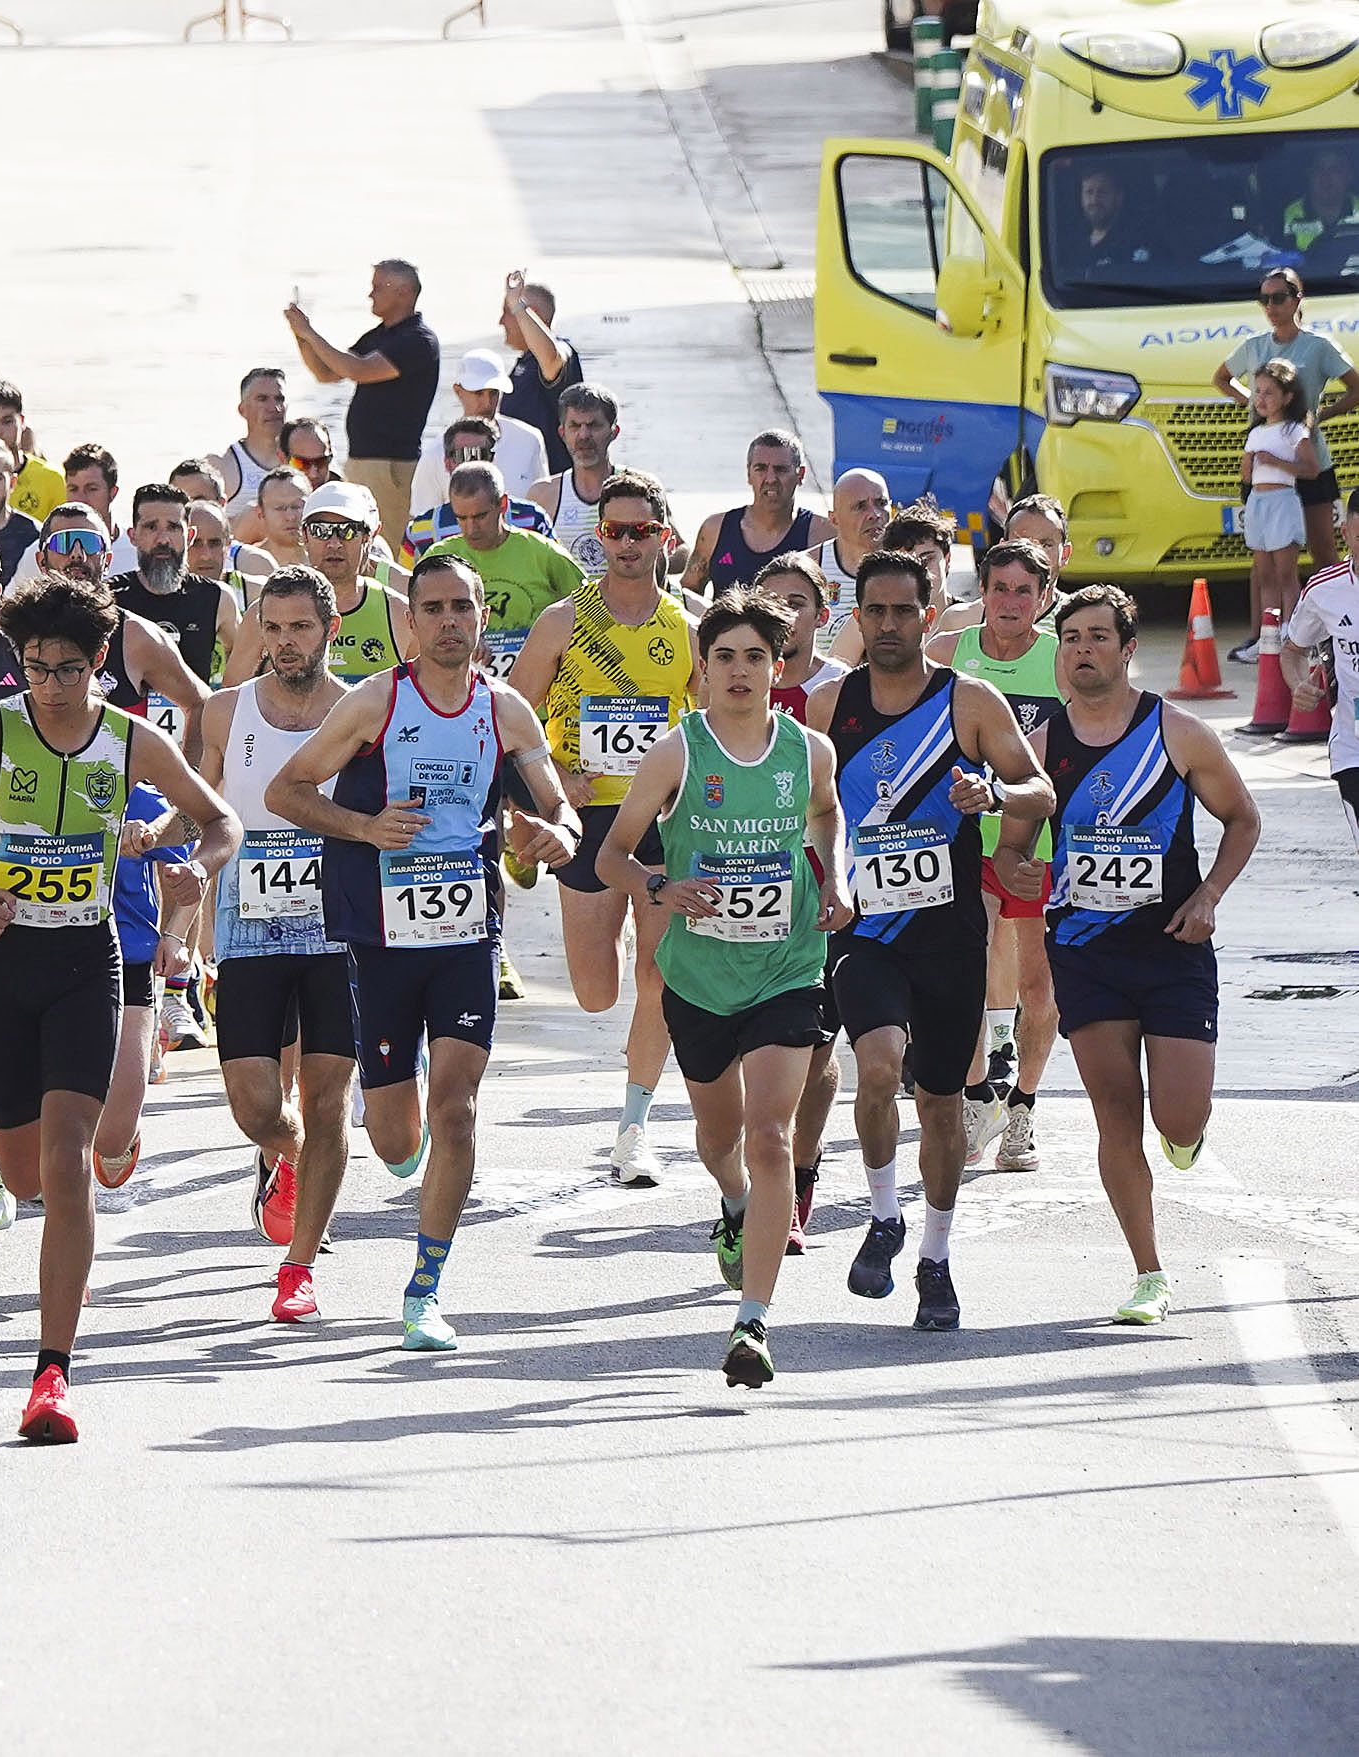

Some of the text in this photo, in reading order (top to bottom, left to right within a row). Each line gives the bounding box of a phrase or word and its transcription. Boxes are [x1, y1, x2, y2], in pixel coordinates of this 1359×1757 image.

[147, 697, 162, 706] IO
[630, 703, 660, 712] FÁTIMA
[608, 712, 635, 721] POIO
[592, 724, 657, 754] 163
[244, 733, 256, 767] evelb
[414, 762, 454, 772] CONCELLO
[418, 772, 449, 781] DE VIGO
[429, 788, 455, 797] XUNTA
[690, 815, 727, 834] SAN
[878, 823, 907, 833] XXXVII
[858, 833, 892, 844] MARATÓN
[900, 827, 936, 839] FÁTIMA
[1072, 834, 1107, 843] MARATÓN
[1116, 835, 1151, 844] FÁTIMA
[33, 838, 65, 846] XXXVII
[288, 837, 324, 847] FÁTIMA
[716, 835, 781, 855] MARÍN
[879, 840, 907, 851] POIO
[7, 844, 47, 854] MARATÓN
[57, 843, 94, 855] FÁTIMA
[266, 849, 294, 857] POIO
[1093, 844, 1121, 852] POIO
[30, 856, 63, 865] POIO
[413, 855, 443, 864] XXXVII
[725, 858, 755, 866] XXXVII
[389, 864, 427, 874] MARATÓN
[437, 860, 473, 871] FÁTIMA
[699, 862, 737, 874] MARATÓN
[747, 862, 782, 874] FÁTIMA
[865, 850, 940, 889] 130
[1076, 855, 1153, 889] 242
[250, 859, 322, 895] 144
[413, 872, 443, 882] POIO
[721, 875, 752, 883] POIO
[7, 866, 93, 903] 255
[396, 883, 473, 921] 139
